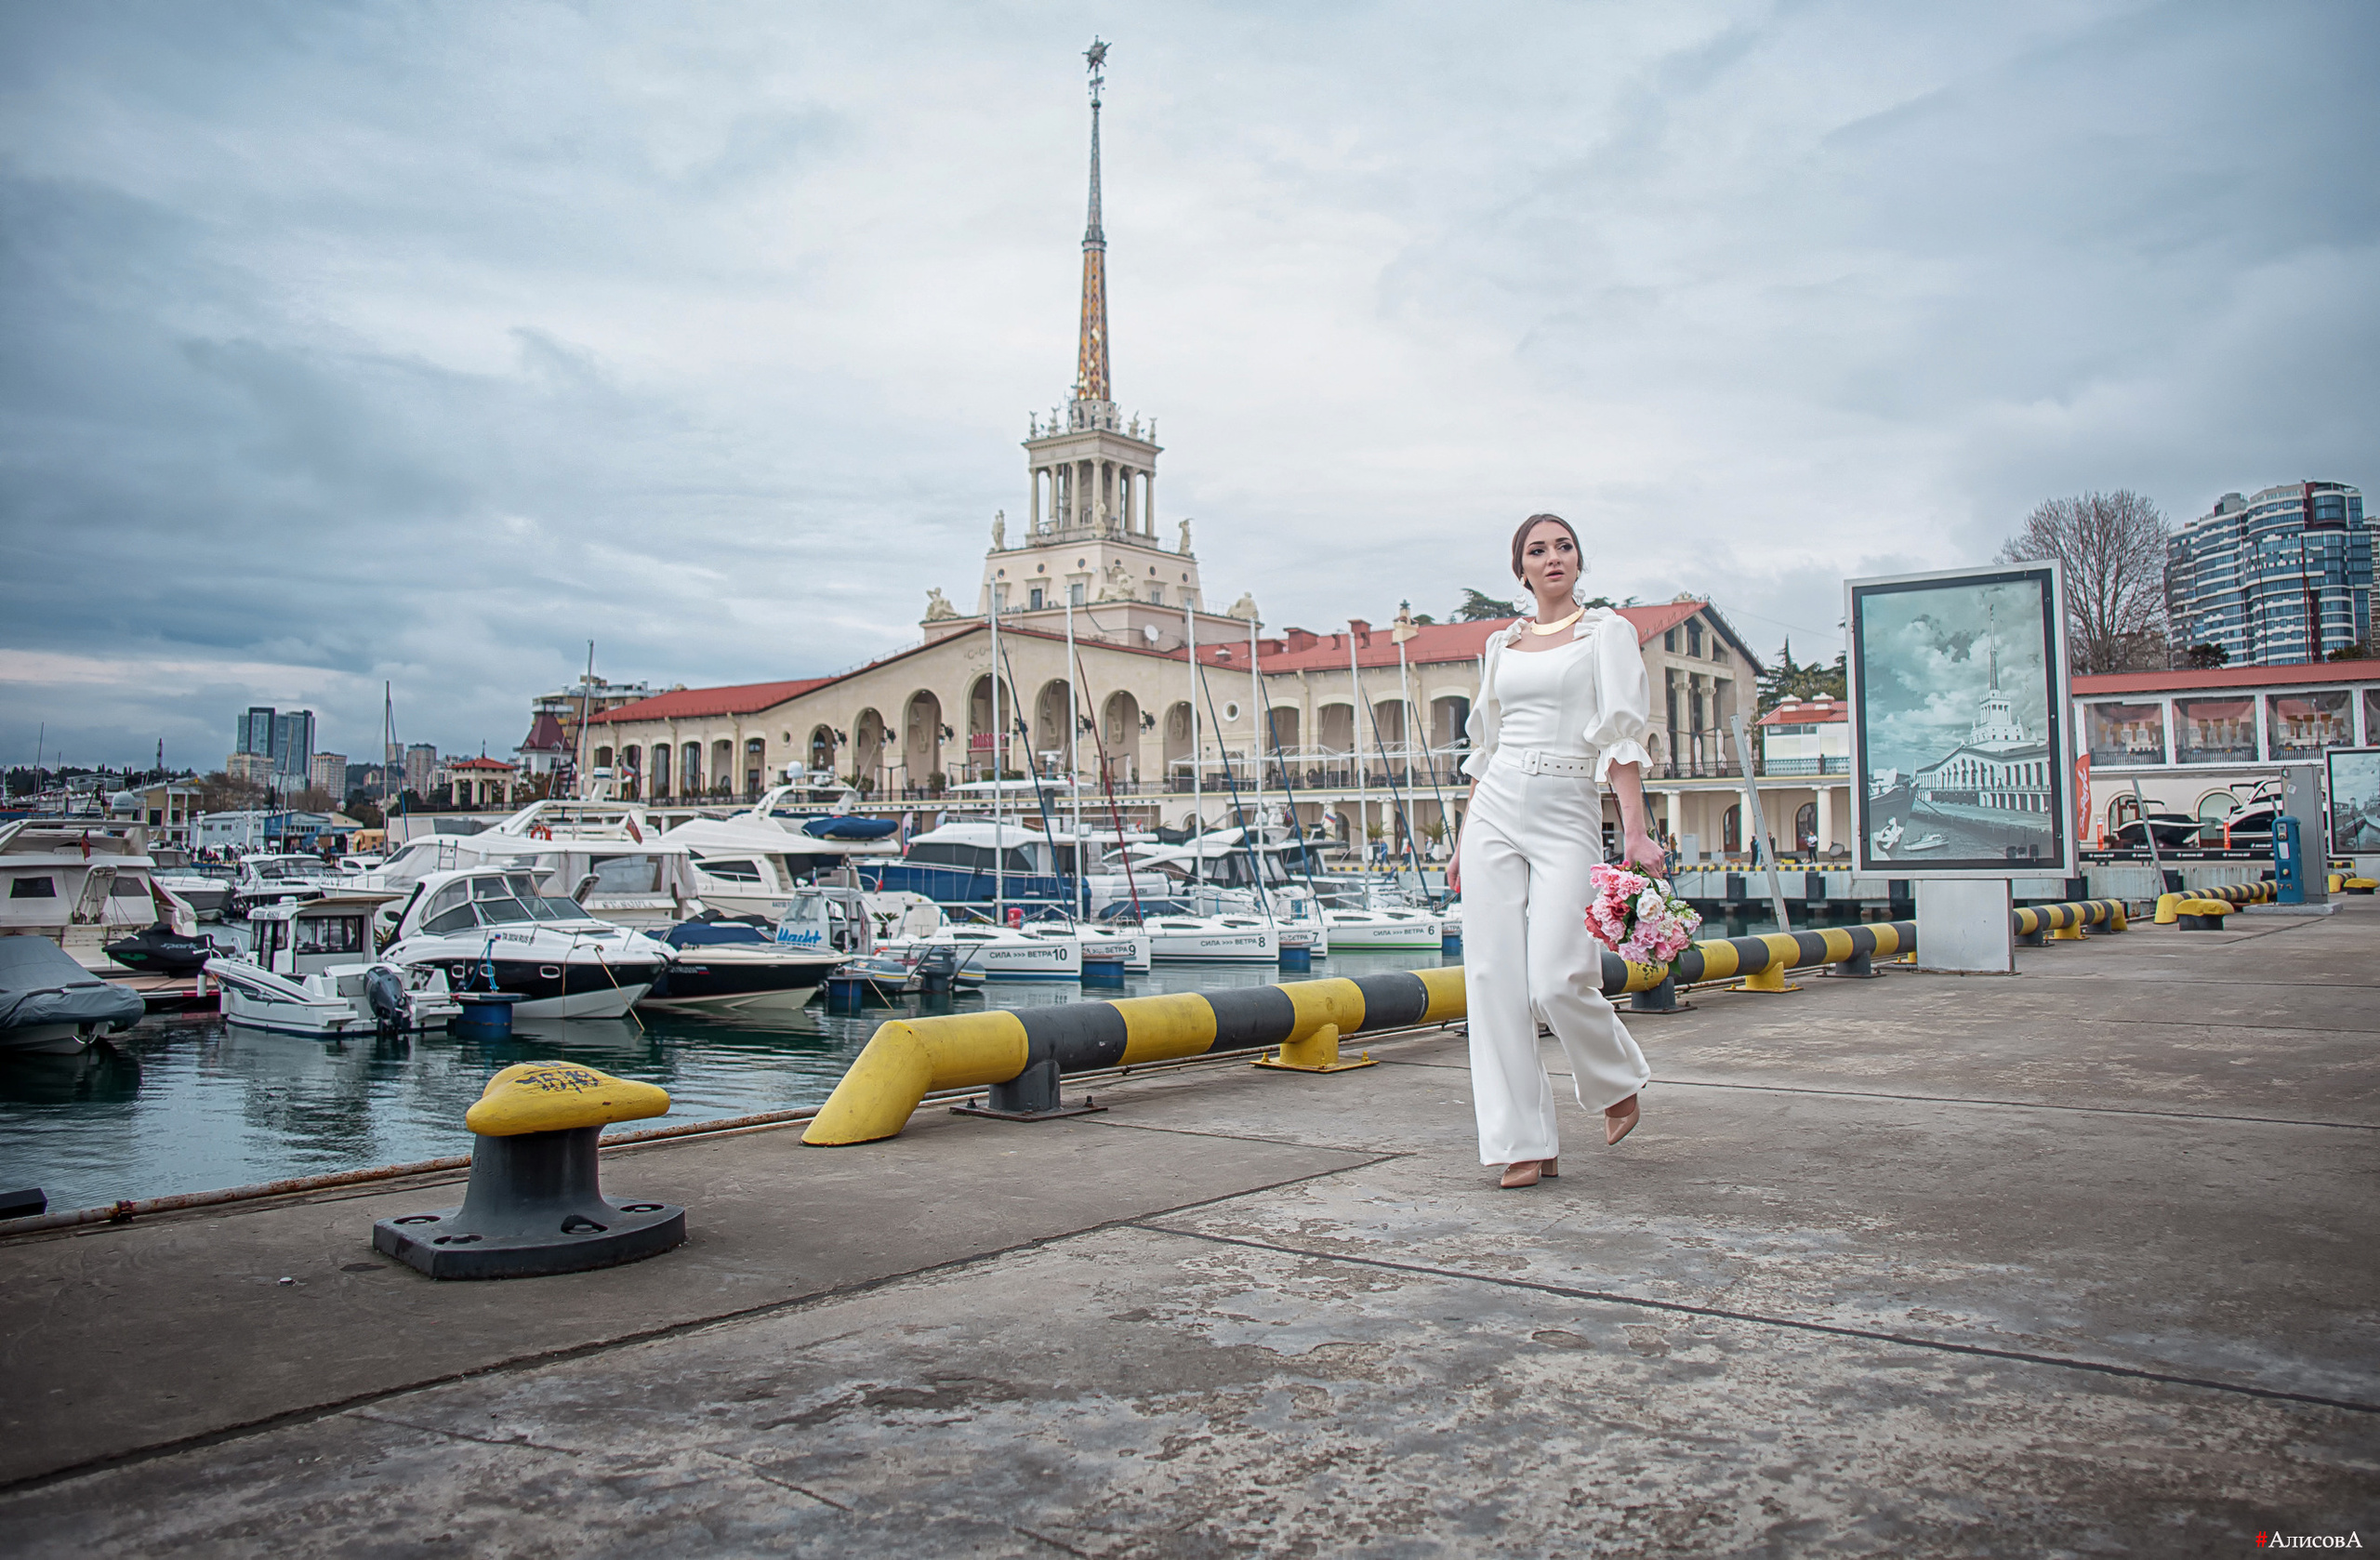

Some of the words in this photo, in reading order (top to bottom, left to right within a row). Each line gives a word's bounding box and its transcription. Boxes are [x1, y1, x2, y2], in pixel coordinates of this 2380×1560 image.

[1427, 925, 1435, 935] 6
[1258, 936, 1266, 947] 8
[1312, 932, 1319, 943] 7
[1027, 950, 1052, 958] ВЕТРА
[1052, 947, 1067, 960] 10
[1128, 944, 1136, 956] 9
